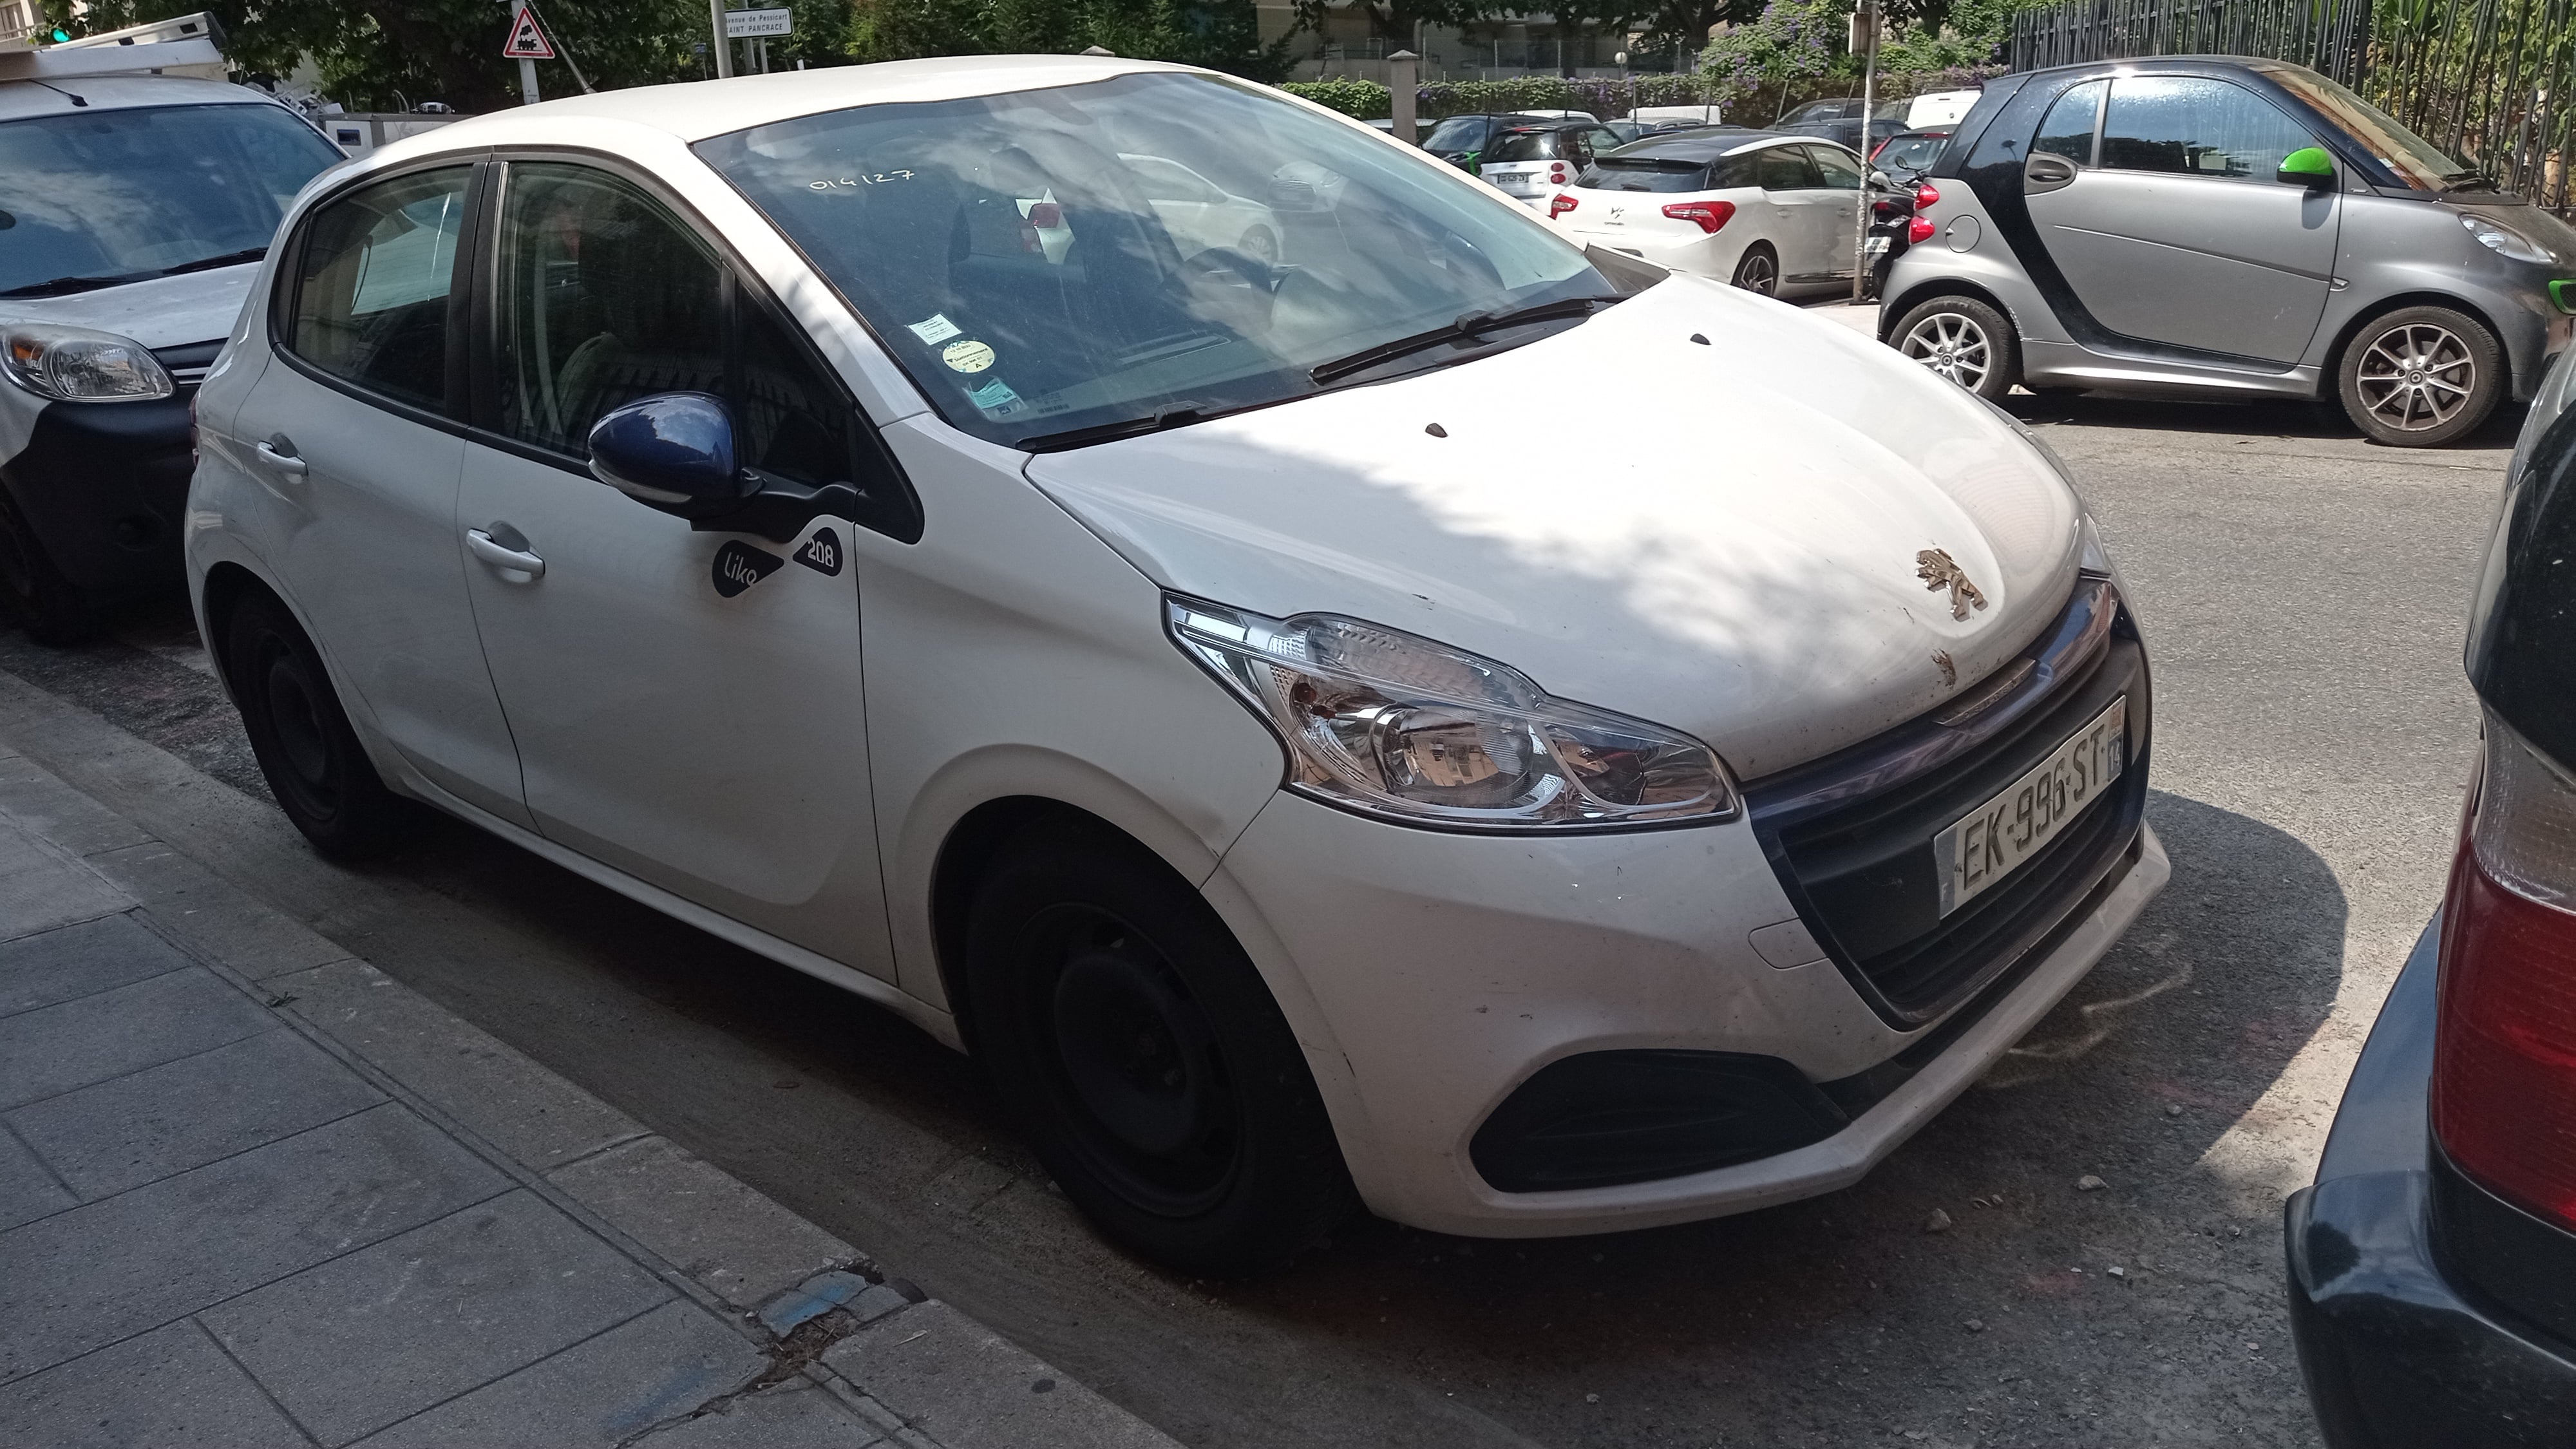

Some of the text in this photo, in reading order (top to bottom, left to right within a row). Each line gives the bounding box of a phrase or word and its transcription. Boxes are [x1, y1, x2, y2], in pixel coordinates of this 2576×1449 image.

[759, 14, 788, 22] Pessicart
[748, 23, 783, 32] PANCRACE
[954, 348, 989, 362] Stationnement
[808, 538, 835, 568] 208
[1964, 723, 2106, 891] EK-996-ST
